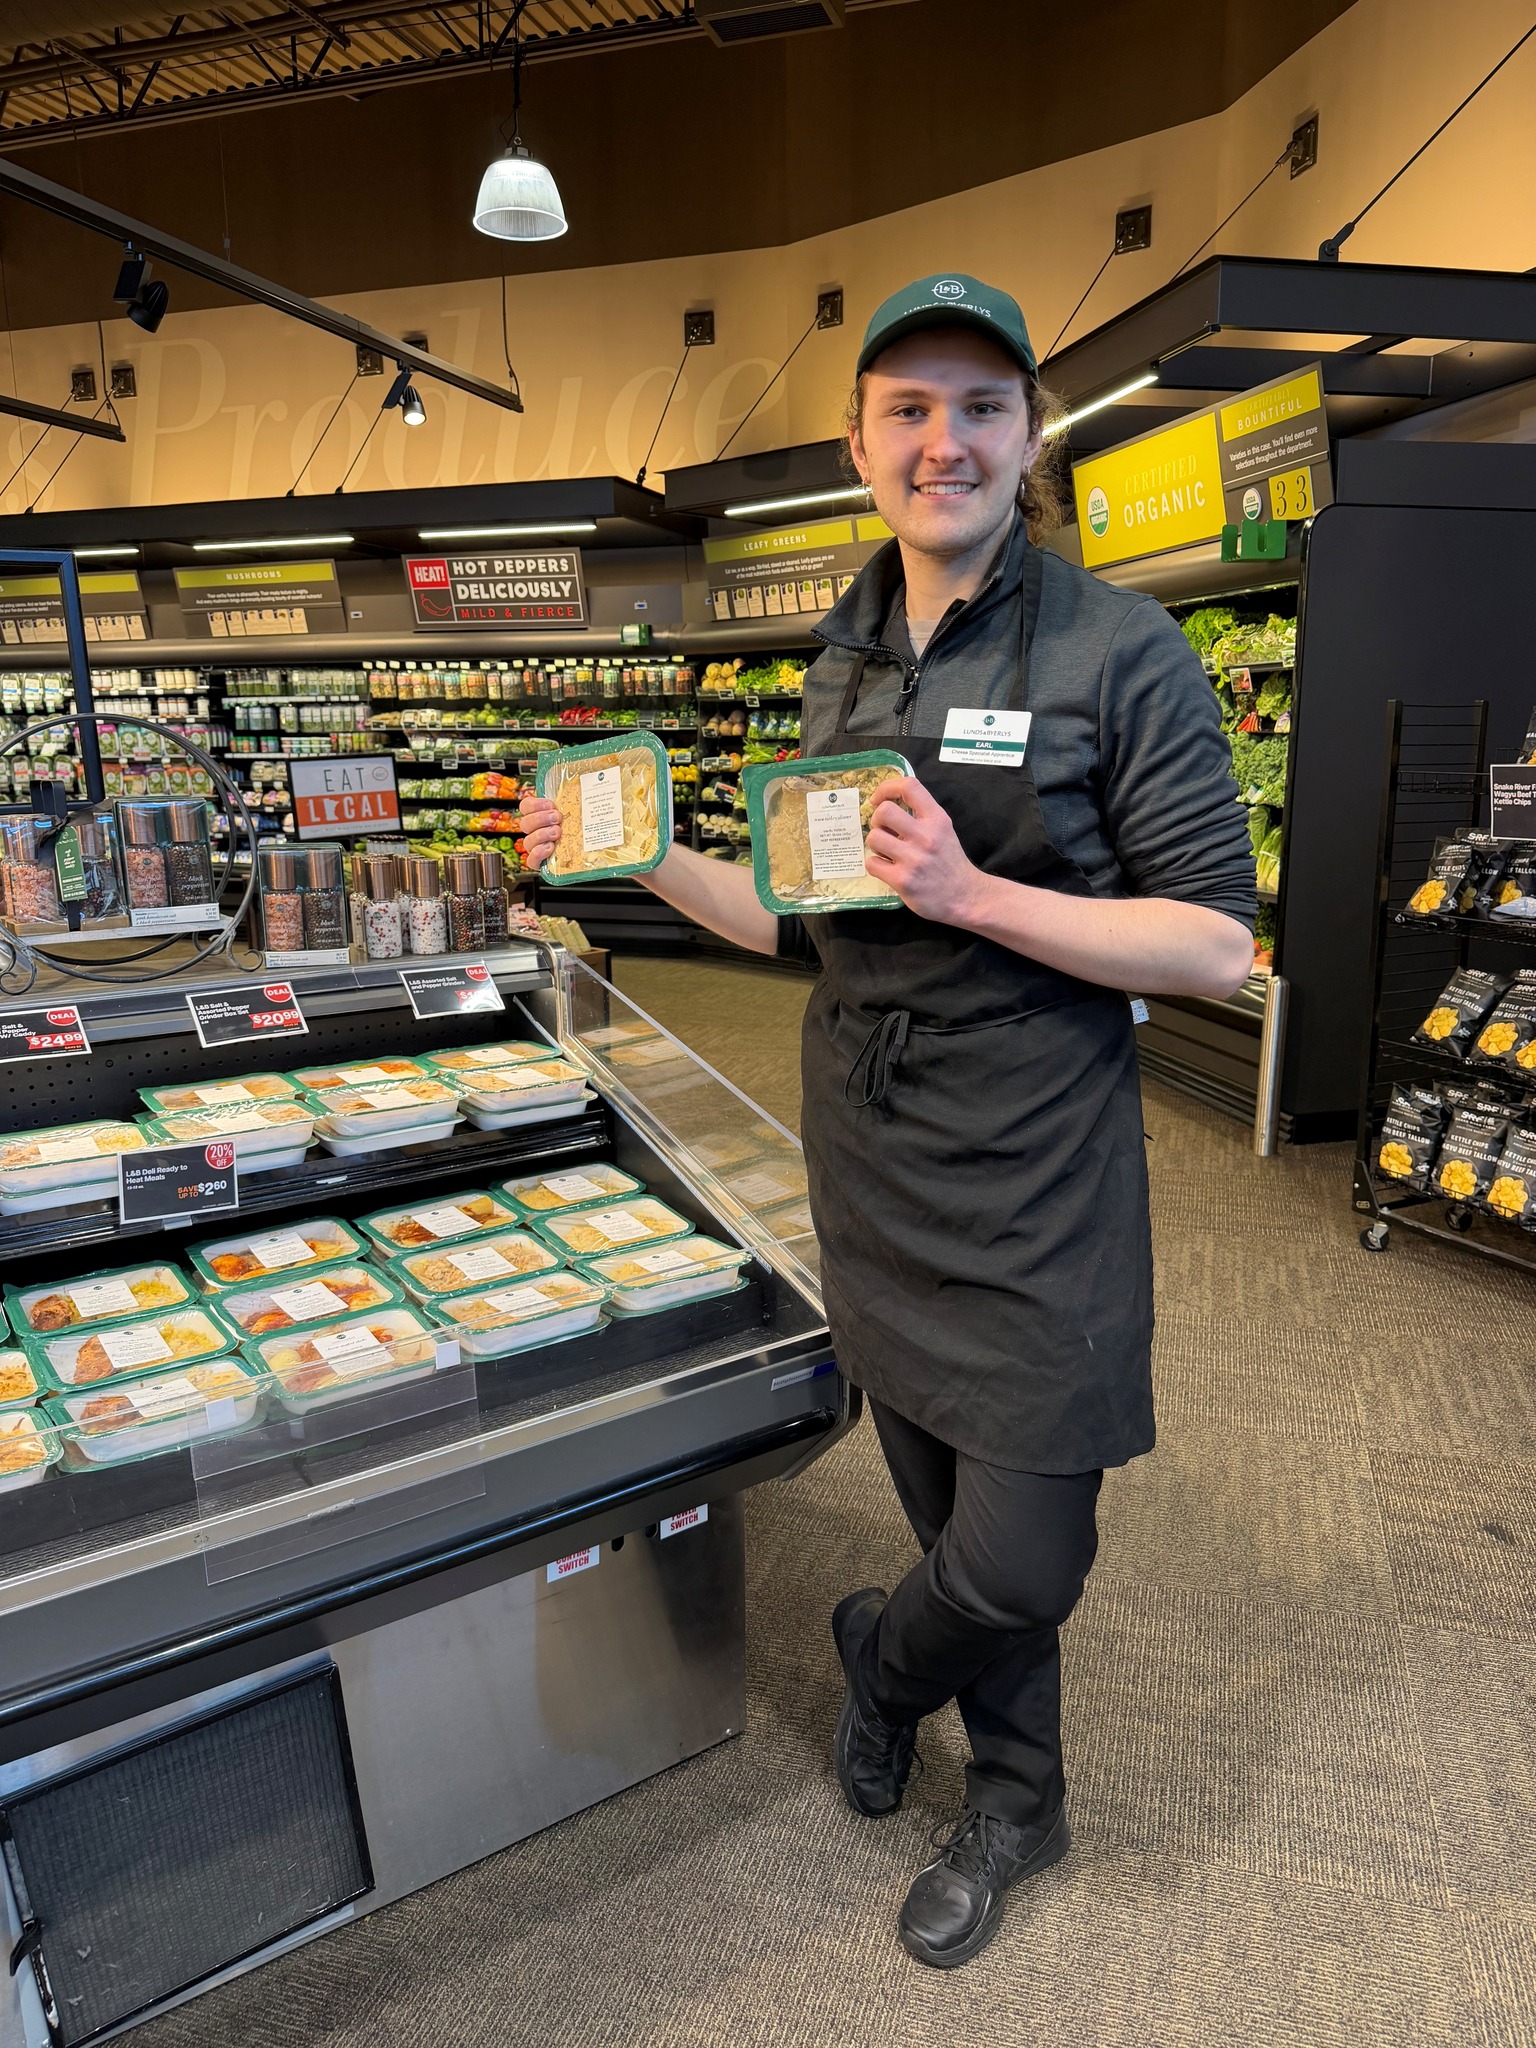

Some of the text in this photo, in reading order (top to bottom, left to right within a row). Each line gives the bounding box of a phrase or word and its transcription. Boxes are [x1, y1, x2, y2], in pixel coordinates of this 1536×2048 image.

[939, 285, 960, 294] L&B
[1237, 398, 1303, 431] BOUNTIFUL
[1125, 455, 1197, 496] CERTIFIED
[1091, 497, 1105, 512] USDA
[1124, 481, 1206, 528] ORGANIC
[743, 534, 808, 551] LEAFY GREENS
[452, 558, 570, 575] HOT PEPPERS
[226, 571, 282, 581] MUSHROOMS
[414, 566, 447, 583] HEAT!
[456, 581, 572, 600] DELICIOUSLY
[460, 606, 575, 619] MILD & FIERCE
[975, 741, 994, 749] EARL
[969, 750, 990, 758] Specialist
[323, 767, 364, 793] EAT
[1493, 783, 1514, 791] Snake
[1514, 783, 1531, 791] River
[1493, 790, 1517, 799] Wagyu
[1513, 798, 1532, 807] Chips
[1467, 832, 1489, 842] SRF
[1467, 969, 1488, 978] SRF
[422, 982, 442, 990] Pepper
[267, 988, 290, 996] DEAL
[1465, 990, 1481, 1000] CHIPS
[198, 1004, 250, 1015] Assorted Pepper
[1463, 999, 1485, 1014] TALLOW
[50, 1012, 76, 1020] DEAL
[199, 1012, 224, 1021] Grinder
[1477, 1102, 1500, 1113] SRF
[1461, 1111, 1485, 1121] SRF
[1386, 1117, 1420, 1132] KETTLE CHIPS
[1391, 1129, 1431, 1145] BEEF TALLOW
[1450, 1134, 1489, 1150] KETTLE CHIPS
[210, 1143, 233, 1158] 20%
[1442, 1143, 1498, 1163] AGYU BEEF TALLOW
[1505, 1150, 1527, 1162] KETTLE
[216, 1158, 227, 1167] OFF
[125, 1169, 141, 1178] L&B
[142, 1168, 156, 1176] Deli
[156, 1165, 179, 1175] Ready
[1510, 1164, 1526, 1174] BEEF
[126, 1174, 166, 1185] Heat Meals
[177, 1185, 198, 1194] SAVE
[670, 1512, 699, 1531] SWITCH
[558, 1554, 590, 1574] SWITCH
